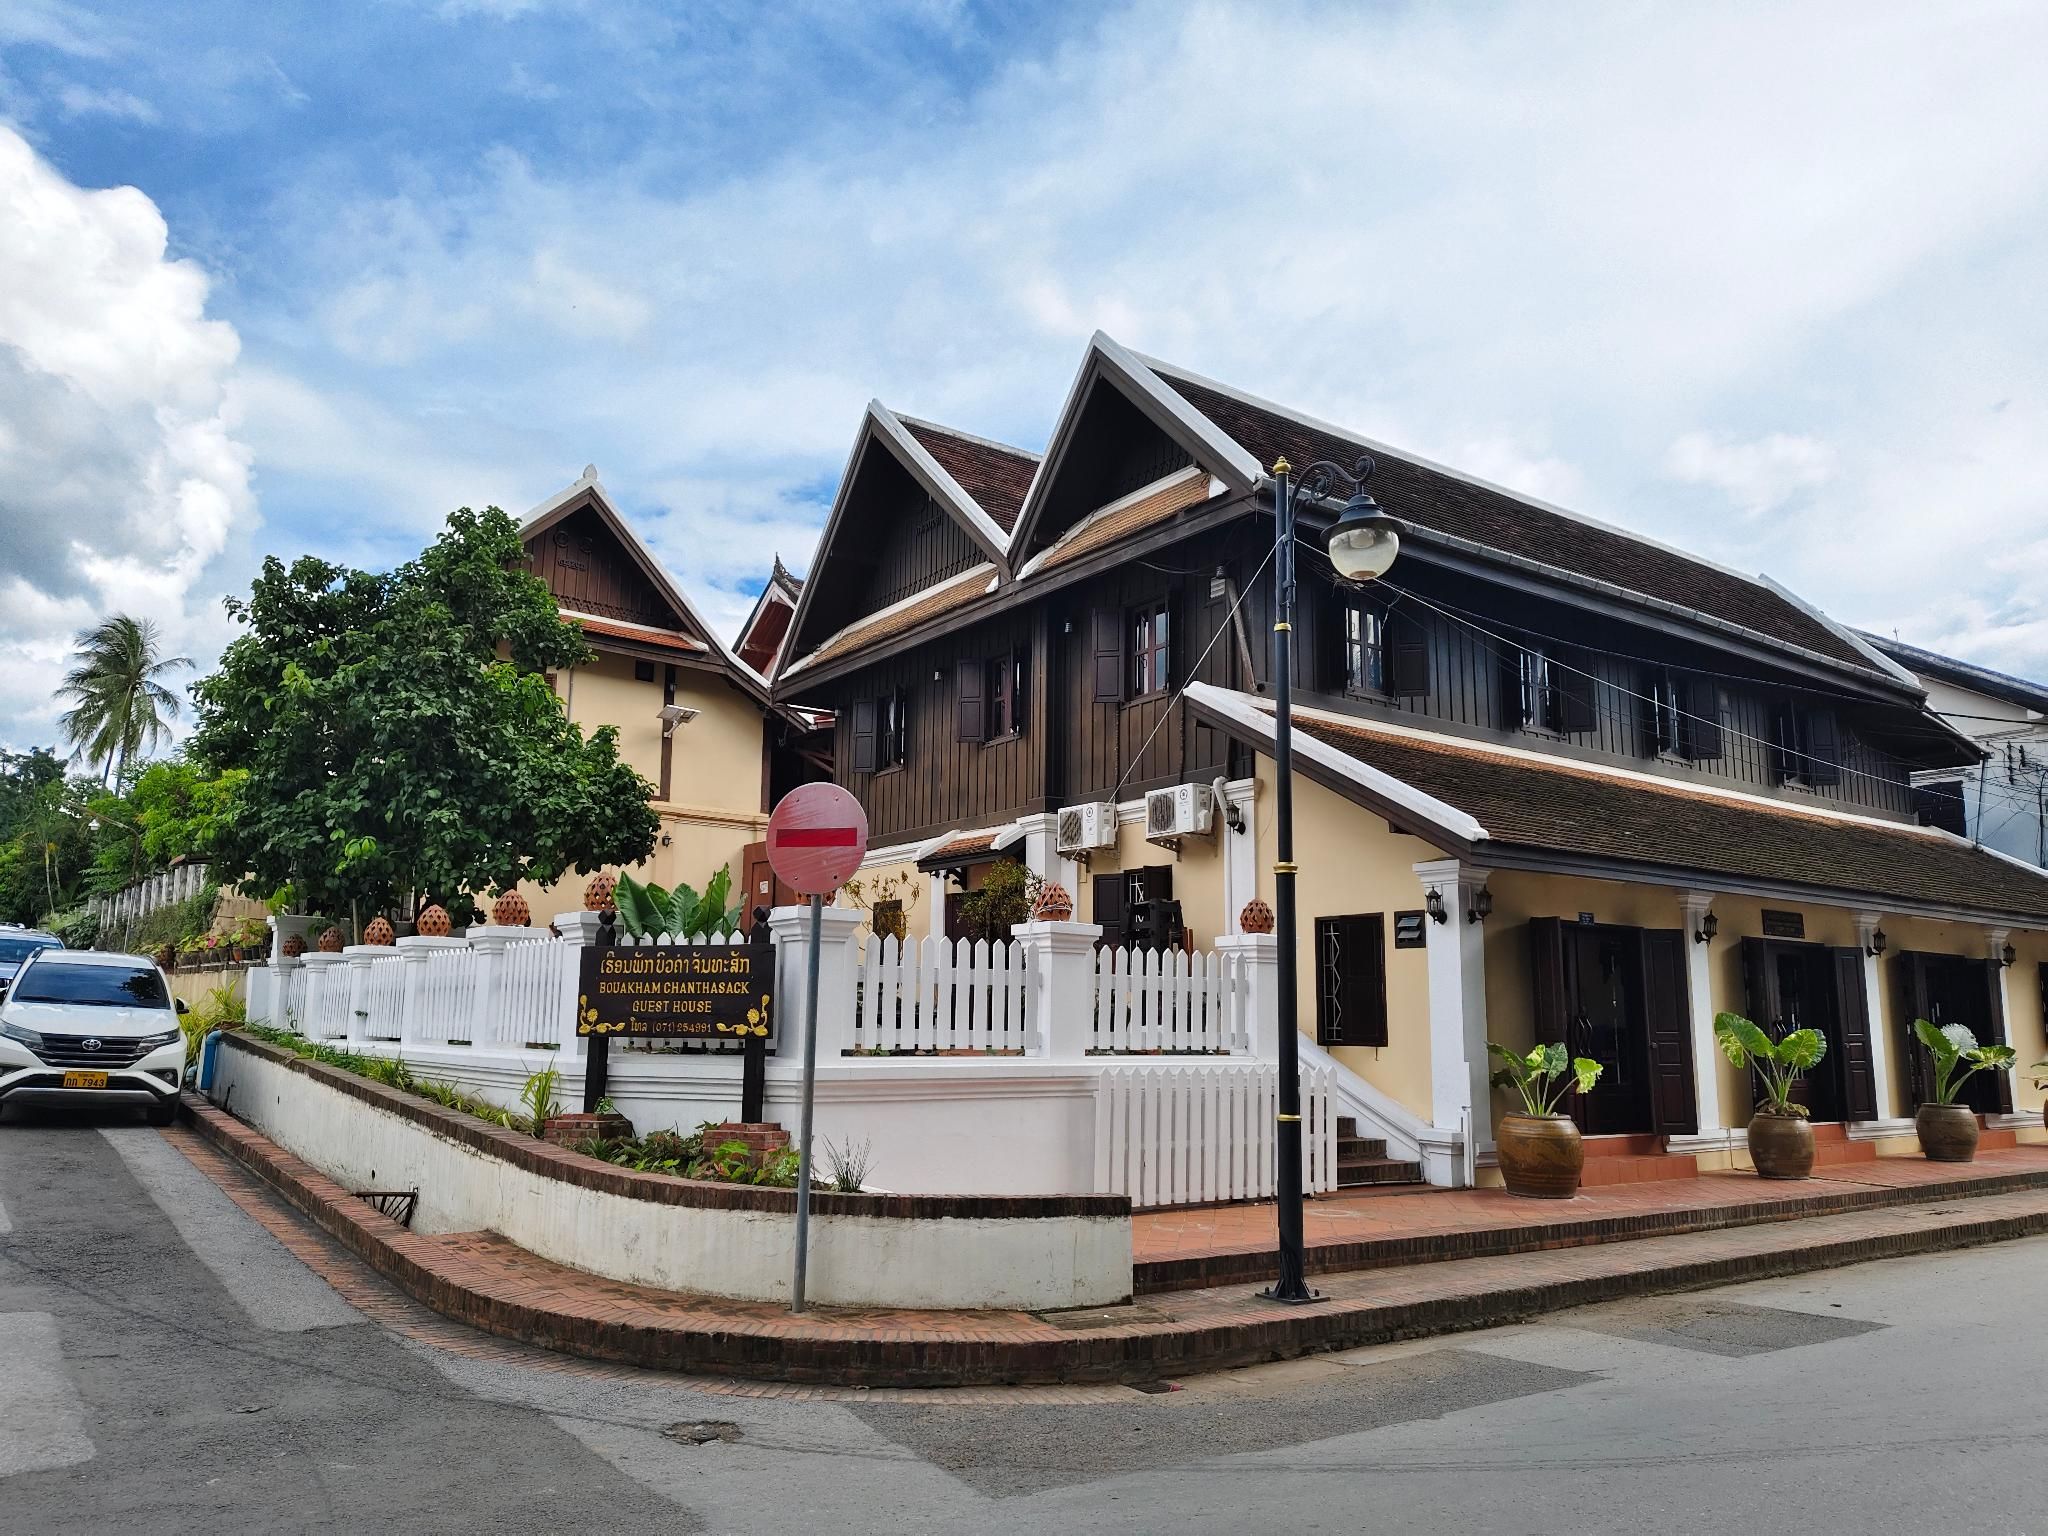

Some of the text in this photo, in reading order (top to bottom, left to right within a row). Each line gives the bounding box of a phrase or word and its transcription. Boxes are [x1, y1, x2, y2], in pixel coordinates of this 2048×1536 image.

[599, 981, 750, 994] BOUAKHAM CHANTHASACK
[632, 1000, 712, 1013] GUEST HOUSE
[82, 1079, 105, 1087] 7943
